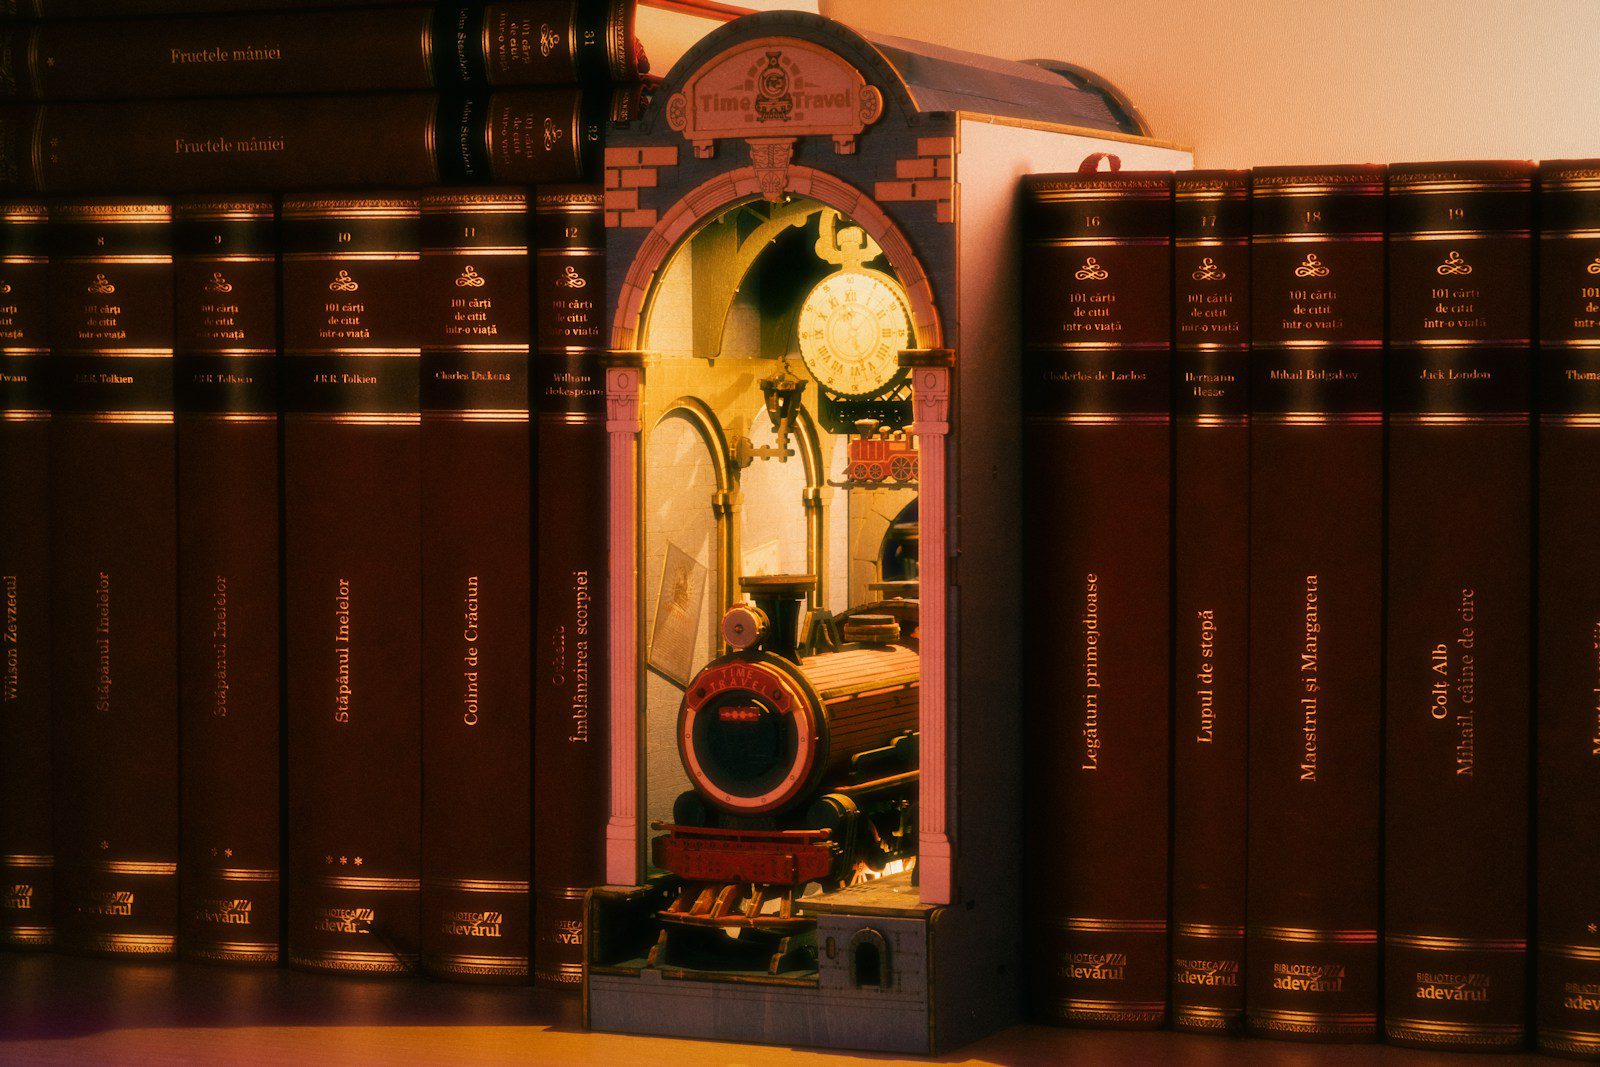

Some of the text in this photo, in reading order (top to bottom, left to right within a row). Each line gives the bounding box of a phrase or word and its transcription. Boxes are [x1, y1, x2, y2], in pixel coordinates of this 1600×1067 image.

[510, 23, 518, 37] de
[584, 30, 595, 46] 31
[170, 44, 282, 64] Fructele mâniei
[700, 89, 851, 113] Time Travel
[587, 125, 597, 141] 32
[175, 136, 285, 154] Fructele mâniei
[1305, 211, 1321, 222] 18
[1448, 208, 1464, 220] 19
[1085, 216, 1100, 228] 16
[1201, 215, 1216, 227] 17
[338, 232, 351, 243] 10
[463, 227, 476, 238] 11
[564, 227, 578, 238] 12
[97, 236, 105, 246] 8
[214, 234, 222, 244] 9
[1289, 289, 1337, 302] 101 cărți
[1431, 287, 1480, 300] 101 cărți
[1581, 287, 1600, 298] 101
[1070, 292, 1116, 305] 101 cărți
[1188, 292, 1233, 305] 101 cărți
[99, 304, 121, 315] cărți
[217, 304, 239, 315] cărți
[325, 303, 365, 315] 101 cărți
[451, 299, 492, 310] 101 cărți
[568, 299, 593, 311] cărți
[1293, 305, 1331, 315] de citit
[1435, 303, 1473, 313] de citit
[1585, 302, 1599, 313] de
[454, 312, 487, 321] de citit
[1073, 307, 1110, 317] de citit
[1191, 307, 1227, 317] de citit
[99, 318, 118, 326] citit
[215, 317, 235, 326] citit
[328, 316, 360, 325] de citit
[567, 314, 587, 322] citit
[1282, 318, 1312, 329] într-o
[1424, 318, 1455, 328] într-o
[473, 324, 498, 336] viață
[572, 325, 599, 337] viață
[1063, 320, 1122, 333] într-o viață
[104, 330, 126, 340] viață
[221, 330, 245, 340] viață
[346, 329, 370, 340] viață
[100, 373, 134, 384] Tolkien
[342, 374, 377, 384] Tolkien
[435, 371, 511, 381] Charles Dickens
[1095, 370, 1108, 381] de
[1111, 370, 1147, 381] Laclos
[1184, 371, 1235, 382] Hermann
[1270, 370, 1360, 382] Mihail Bulgakov
[1419, 369, 1491, 380] Jack London
[1193, 386, 1225, 397] Hesse
[97, 572, 110, 633] Inelelor
[214, 576, 227, 638] Inelelor
[4, 576, 18, 703] Wilson Zevzecul
[335, 579, 352, 724] Stăpânul Inelelor
[464, 576, 479, 727] Colind de Crăciun
[569, 570, 592, 743] Îmblânzirea scorpiei
[721, 668, 754, 679] TIME
[1082, 573, 1100, 771] Legături primejdioase
[1197, 609, 1216, 744] Lupul de stepă
[1300, 574, 1320, 782] Maestrul și Margareta
[1431, 643, 1450, 720] Colț Alb
[1456, 587, 1474, 777] Mihail, câine de circ
[709, 678, 771, 694] TRAVEL
[1273, 963, 1322, 974] BIBLIOTECA
[1273, 973, 1342, 992] adevărul
[1416, 983, 1487, 1001] adevărul
